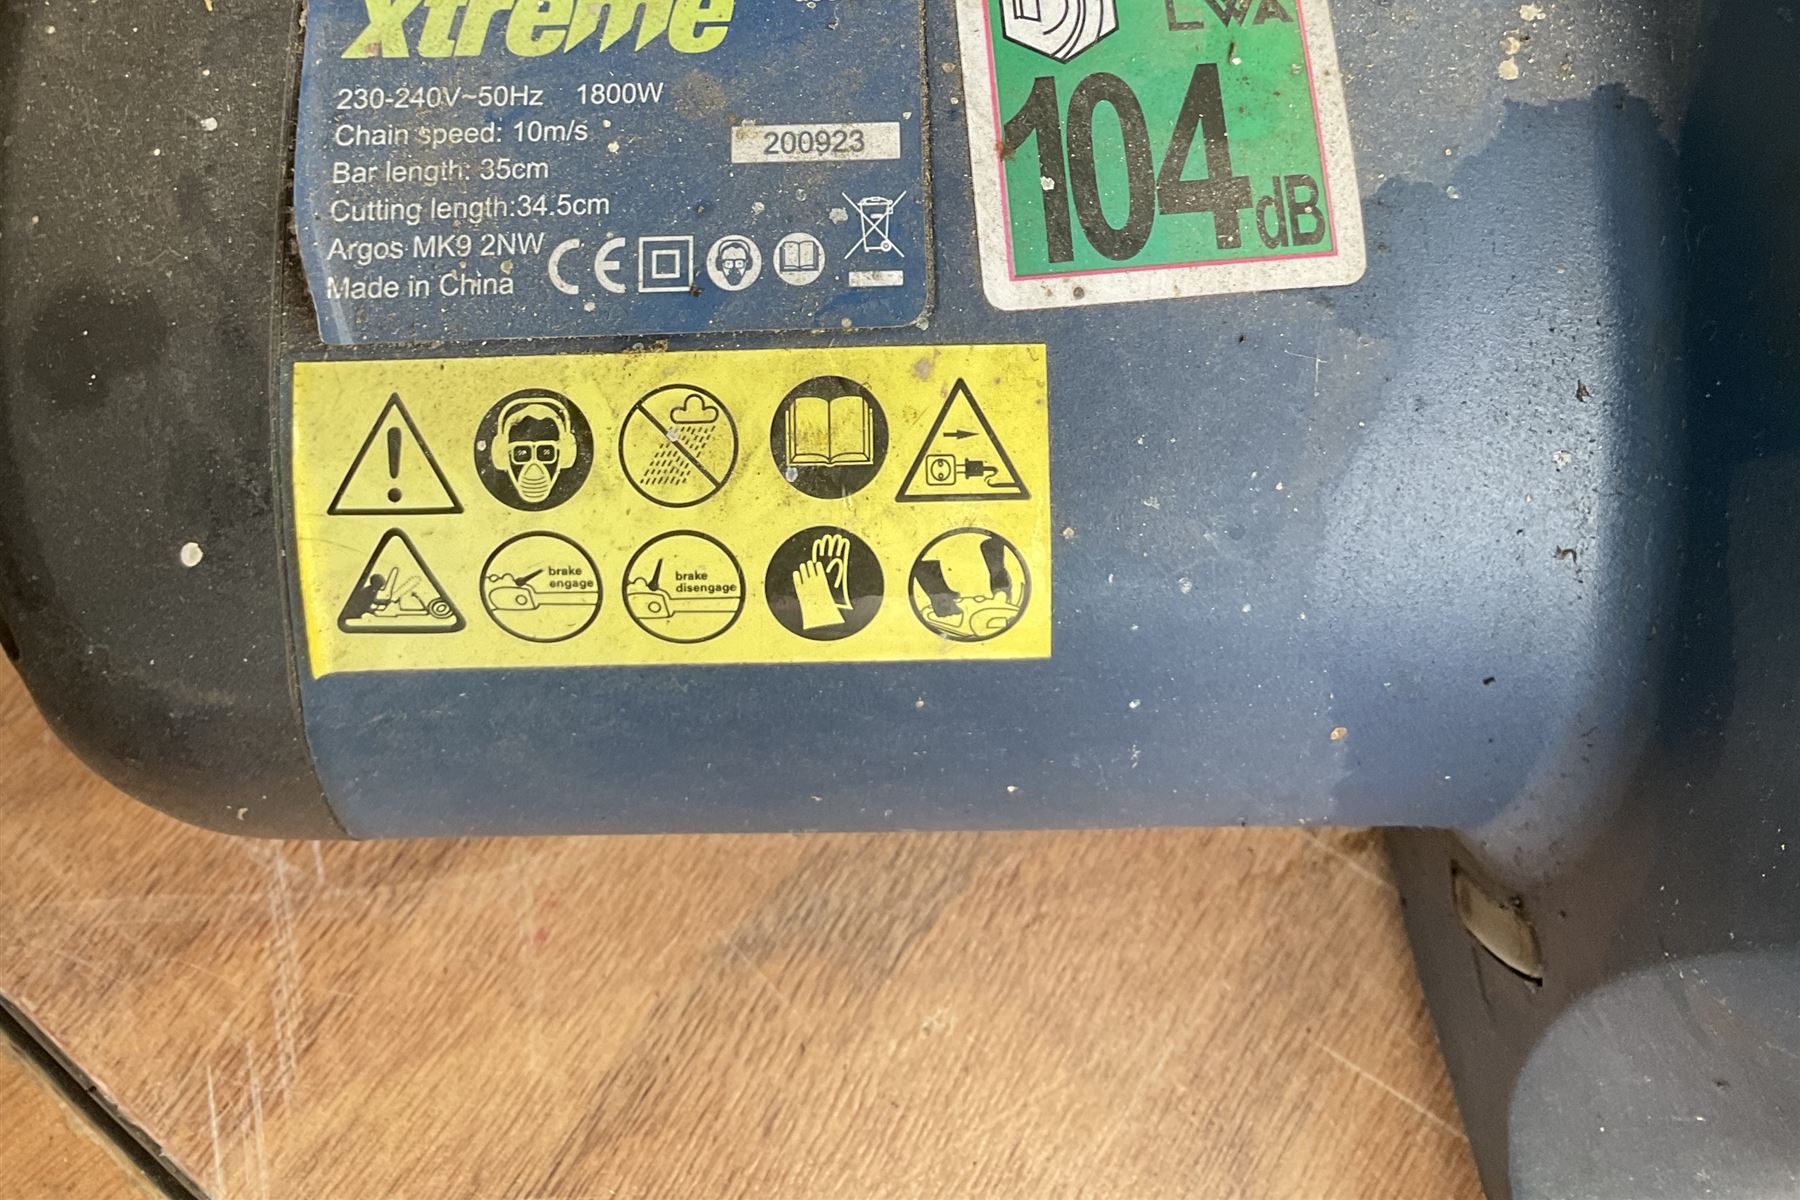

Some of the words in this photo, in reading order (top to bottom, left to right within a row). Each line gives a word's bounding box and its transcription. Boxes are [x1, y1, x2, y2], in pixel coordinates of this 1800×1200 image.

[577, 81, 665, 105] 1800W
[335, 124, 409, 147] Chain
[415, 122, 503, 150] speed:
[513, 119, 589, 144] 10m/s
[762, 129, 866, 156] 200923
[332, 161, 378, 185] Bar
[385, 158, 470, 188] length:
[479, 157, 550, 181] 35cm
[1004, 63, 1254, 264] 104
[1255, 174, 1326, 250] dB
[330, 198, 422, 227] Cutting
[326, 237, 404, 266] Argos
[413, 234, 472, 259] MK9
[480, 231, 546, 258] 2NW
[326, 275, 400, 300] Made
[407, 273, 430, 299] in
[438, 271, 515, 297] China
[548, 565, 583, 577] brake
[549, 578, 595, 590] engage
[674, 570, 709, 582] brake
[675, 582, 737, 594] disengage
